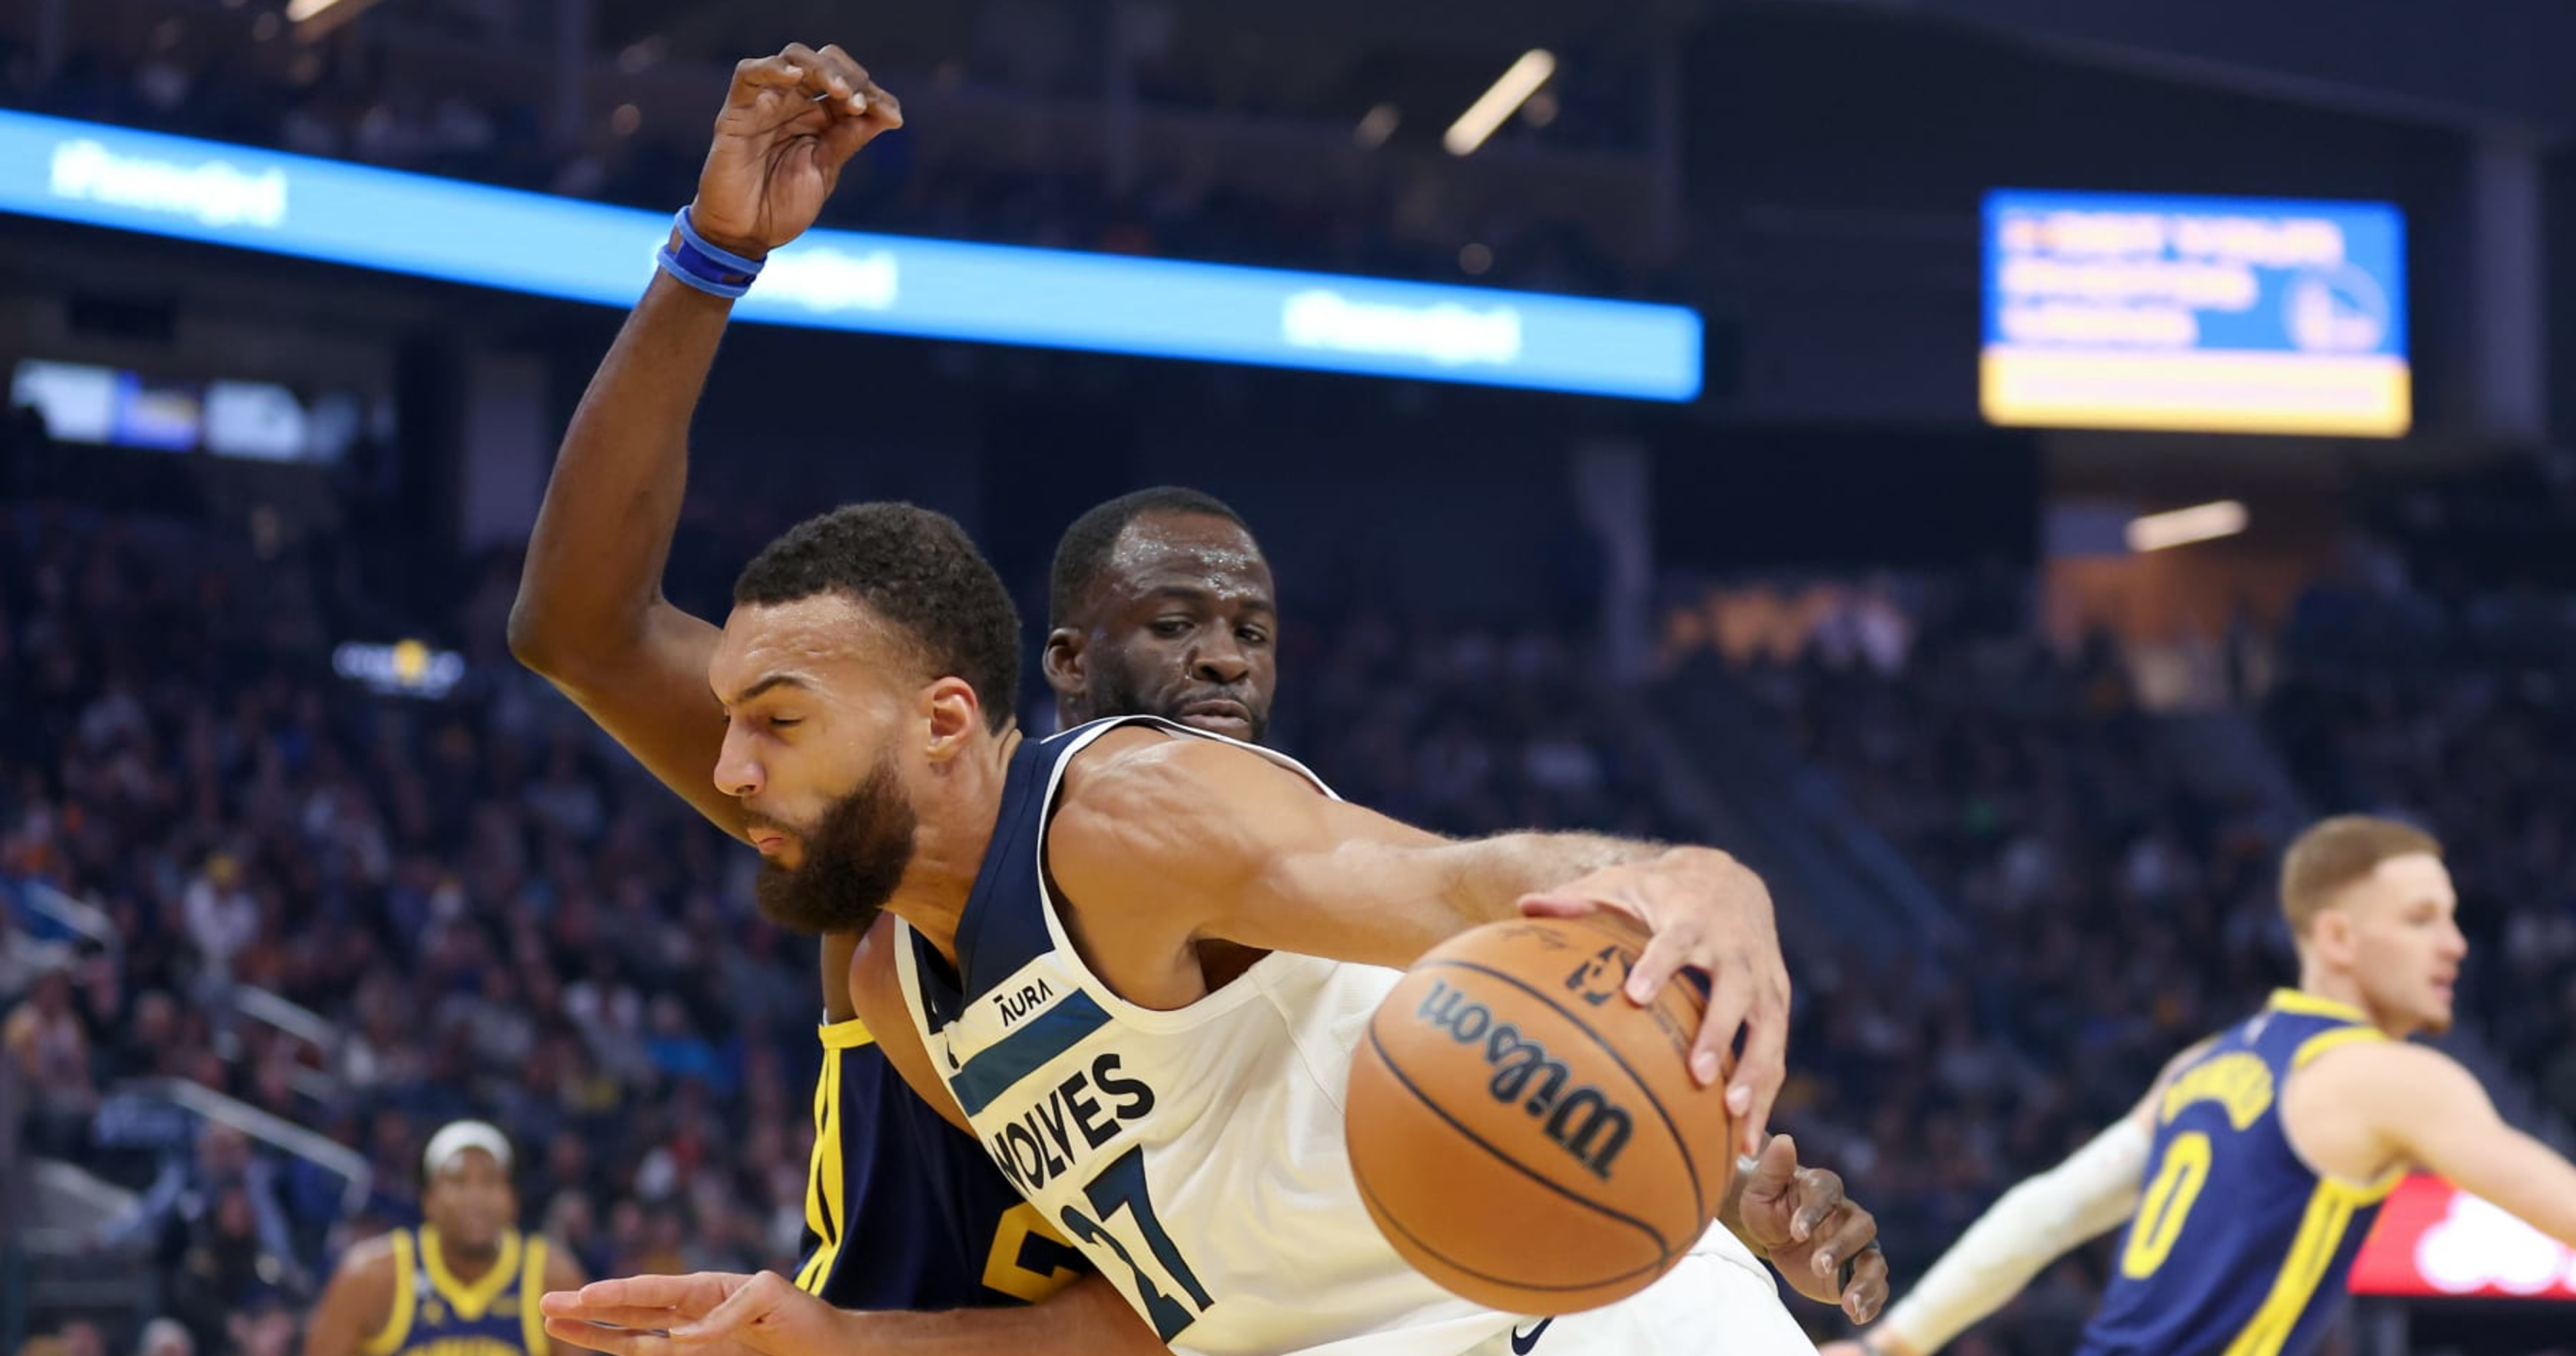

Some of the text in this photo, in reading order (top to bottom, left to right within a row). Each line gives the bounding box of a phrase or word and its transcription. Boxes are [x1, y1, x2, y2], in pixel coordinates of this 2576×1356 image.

[1417, 978, 1634, 1181] Wilson
[1060, 1144, 1215, 1345] 27
[2121, 1131, 2212, 1280] 0
